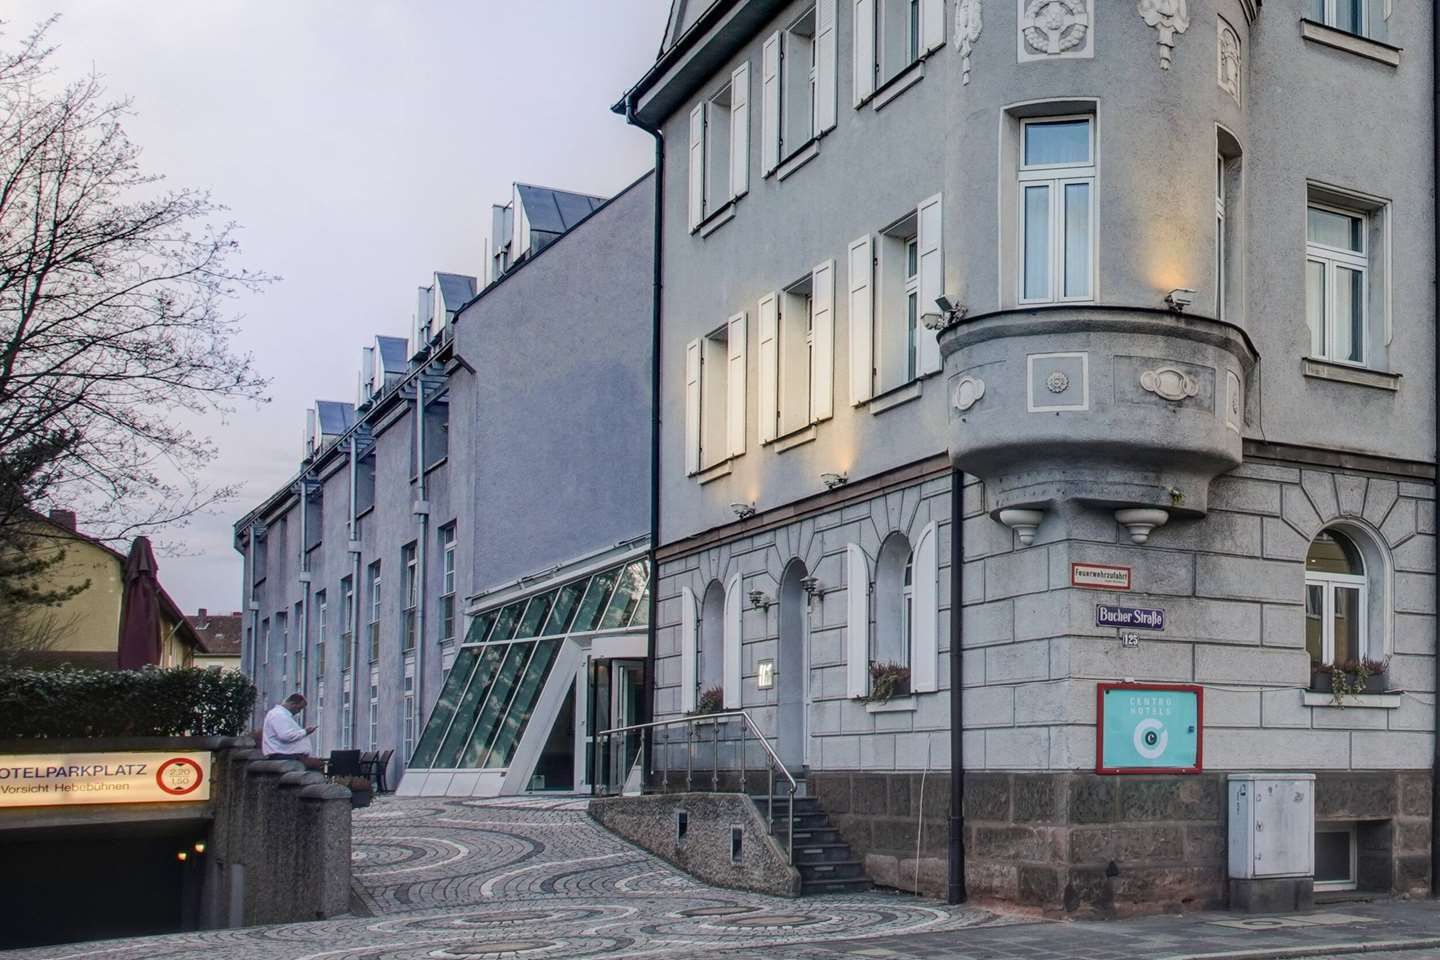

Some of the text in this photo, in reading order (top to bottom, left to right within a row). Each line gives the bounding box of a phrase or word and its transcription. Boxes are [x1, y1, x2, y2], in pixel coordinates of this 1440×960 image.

[1075, 568, 1128, 580] Feuerwehrzufahrt
[1100, 607, 1162, 626] Bucher Straße
[1124, 634, 1138, 645] 125
[1129, 697, 1172, 706] CENTRO
[1129, 706, 1171, 715] HOTELS
[0, 764, 147, 779] OTELPARKPLATZ
[0, 783, 130, 794] Vorsicht Hebebühnen
